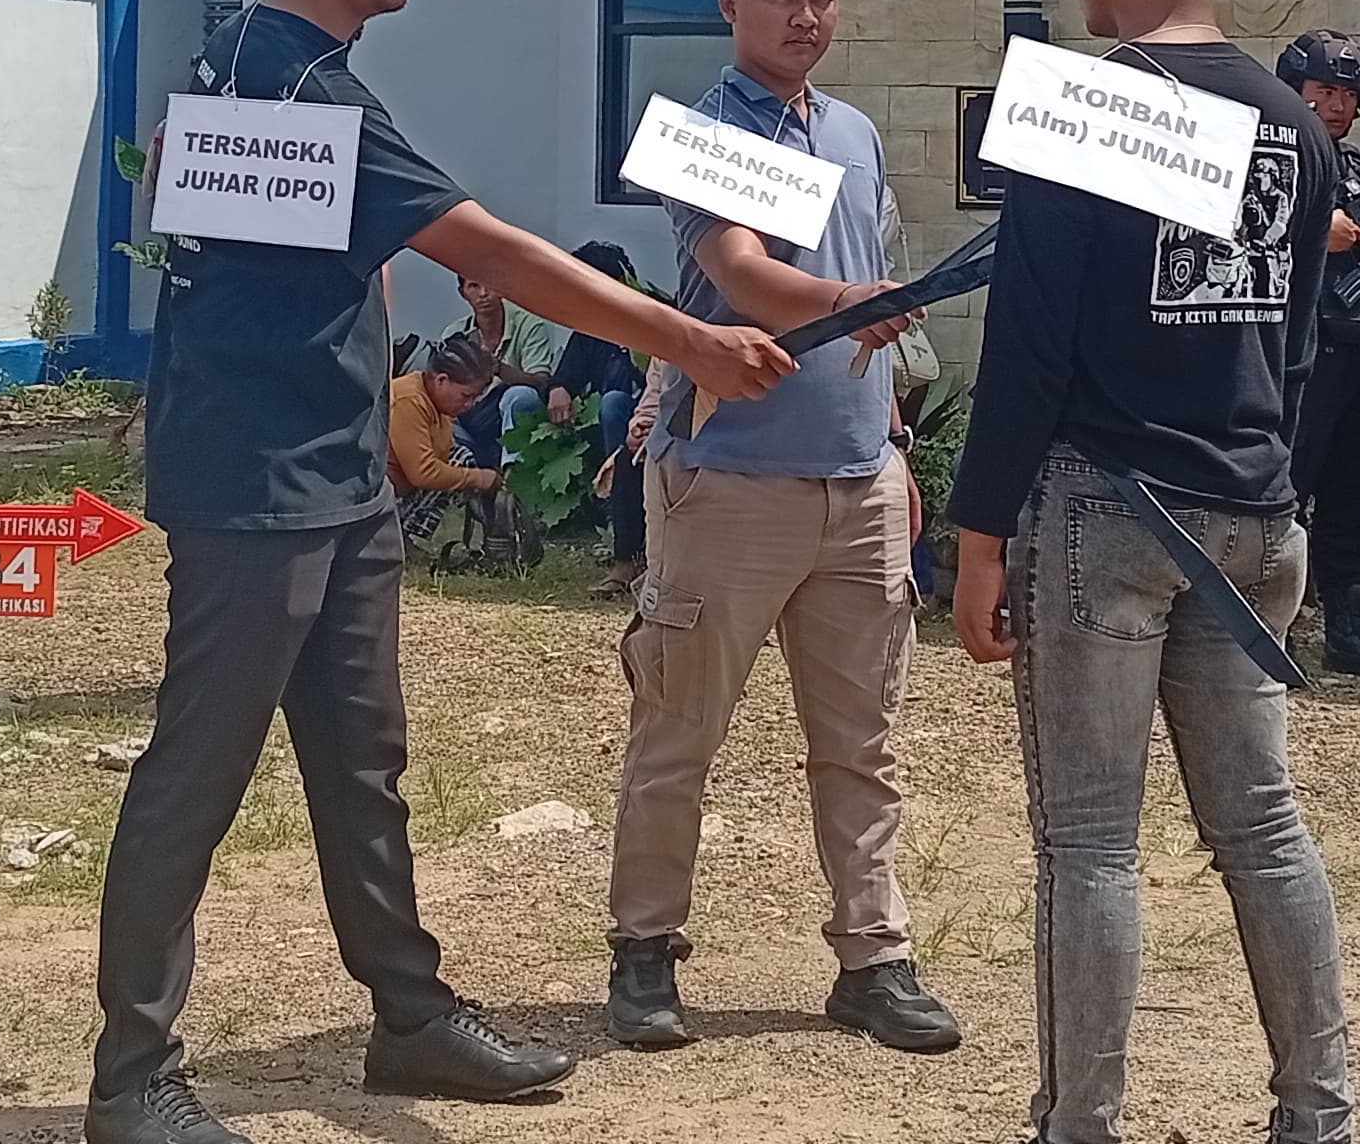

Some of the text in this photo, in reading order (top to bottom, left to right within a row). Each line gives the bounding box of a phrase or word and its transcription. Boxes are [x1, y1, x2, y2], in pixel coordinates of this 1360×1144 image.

[1061, 81, 1197, 139] KORBAN
[184, 132, 335, 165] TERSANGKA
[1007, 102, 1233, 190] (Alm) JUMAIDI
[1255, 124, 1297, 145] ELAH
[659, 120, 822, 199] TERSANGKA
[175, 169, 335, 208] JUHAR (DPO)
[682, 162, 778, 208] ARDAN
[1150, 310, 1181, 324] TAPI
[1185, 310, 1217, 324] KITA
[1221, 309, 1243, 323] GAK
